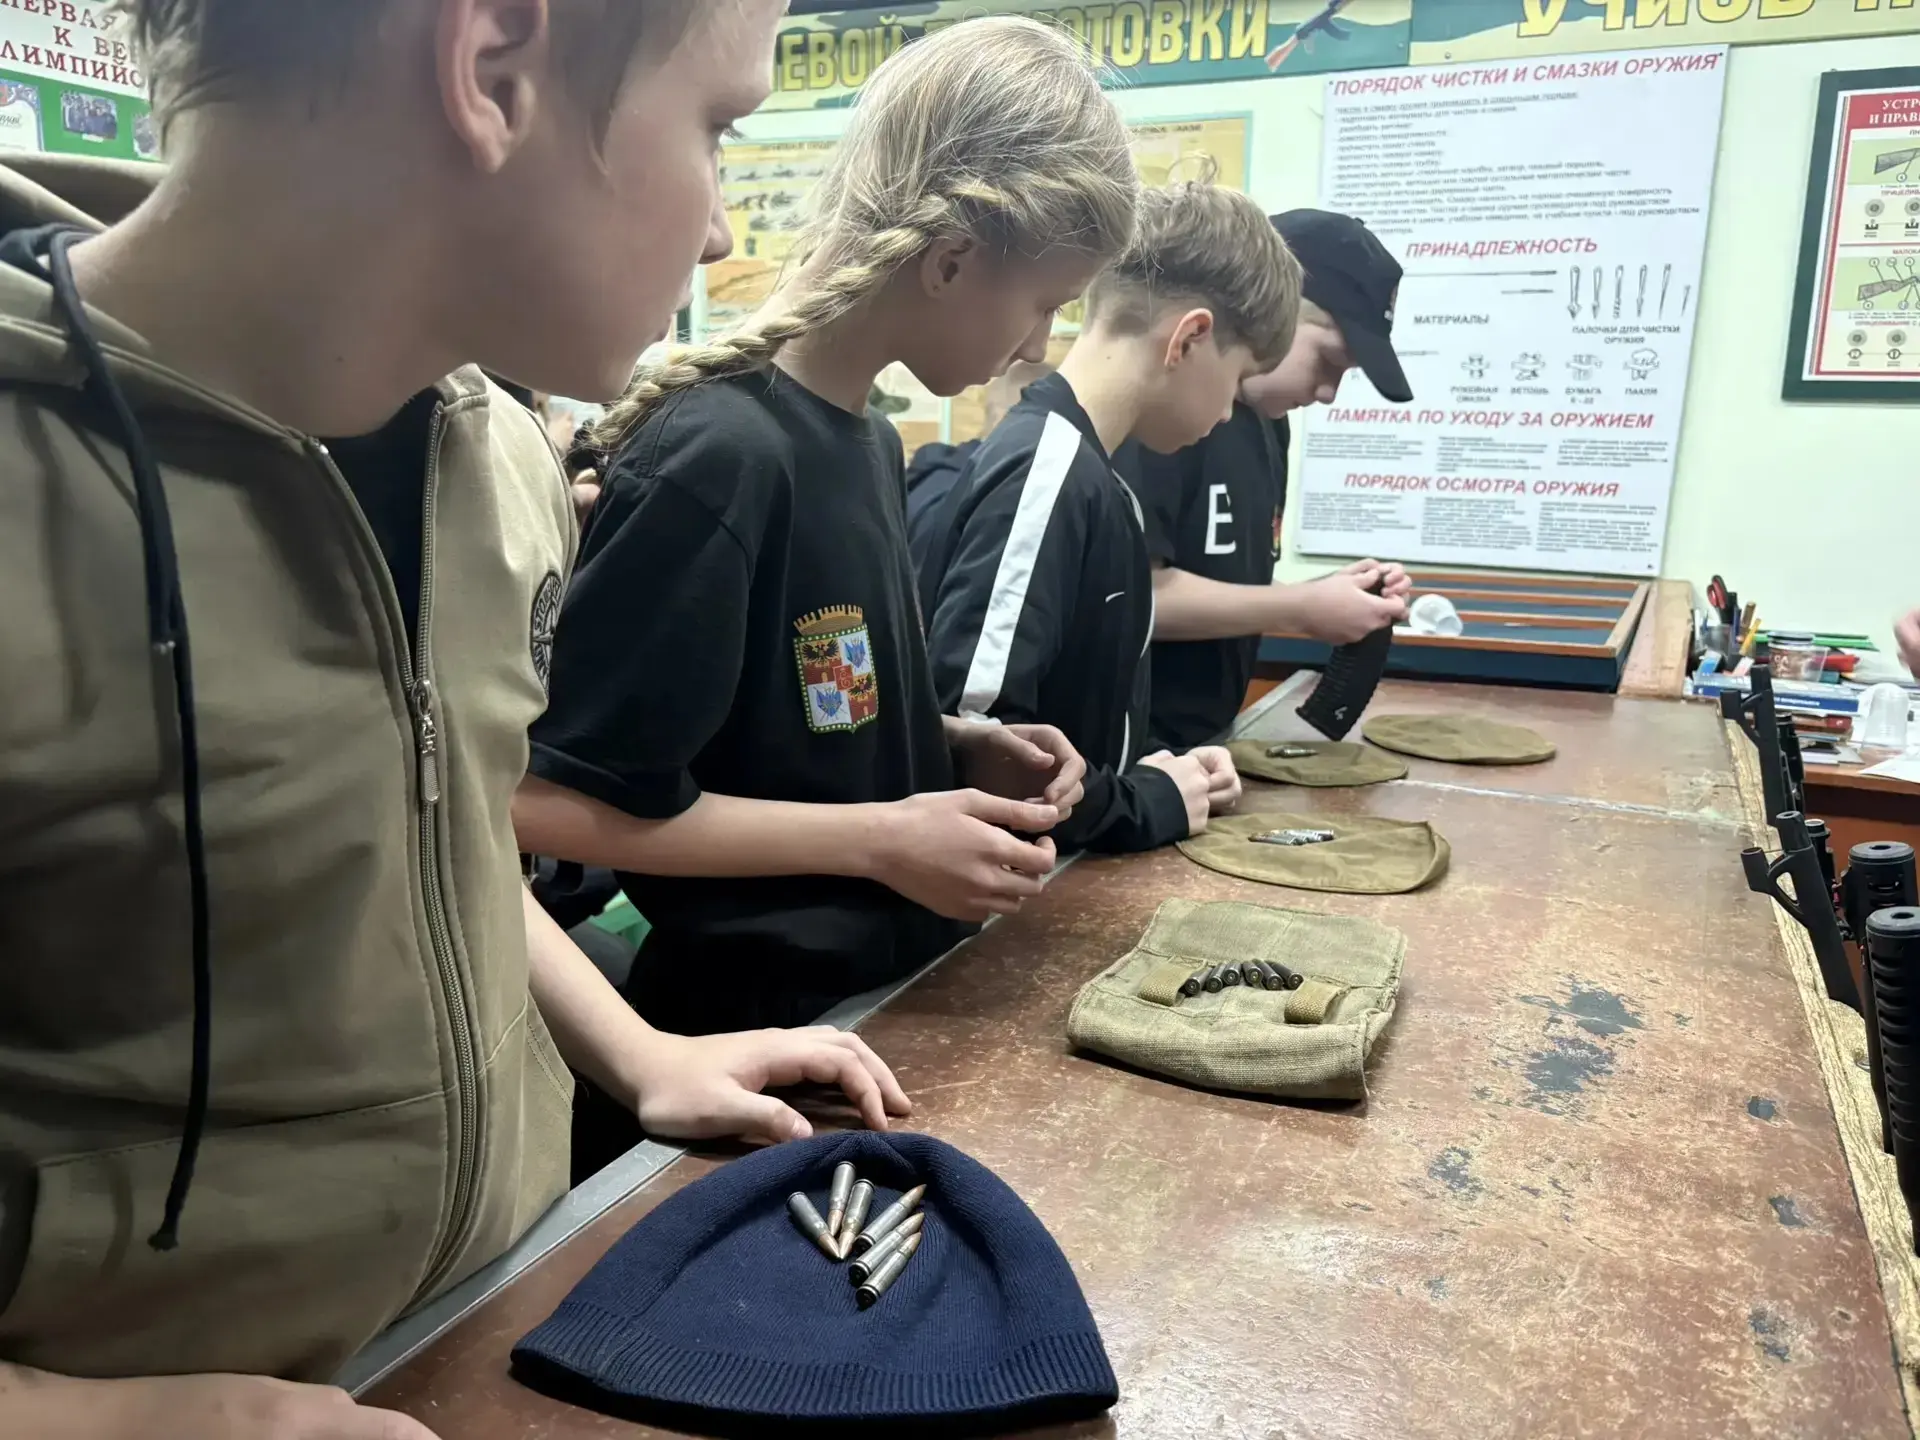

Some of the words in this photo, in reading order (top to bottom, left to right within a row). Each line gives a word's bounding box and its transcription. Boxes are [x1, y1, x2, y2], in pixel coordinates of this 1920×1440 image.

[53, 25, 73, 48] К
[774, 13, 903, 92] ЕВОЙ
[1334, 76, 1424, 96] ПОРЯДОК
[1432, 68, 1507, 88] ЧИСТКИ
[1514, 67, 1527, 82] И
[1533, 61, 1617, 80] СМАЗКИ
[1625, 53, 1718, 75] ОРУЖИЯ
[1882, 99, 1920, 110] УСТР
[1869, 114, 1880, 124] И
[1883, 112, 1920, 123] ПРАВ
[1406, 237, 1597, 258] ПРИНАДЛЕЖНОСТЬ
[1414, 314, 1490, 325] МАТЕРИАЛЫ
[1572, 326, 1617, 334] ПАЛОЧКИ
[1641, 325, 1681, 333] ЧИСТКИ
[1327, 408, 1412, 424] ПАМЯТКА
[1417, 409, 1444, 425] ПО
[1449, 410, 1515, 428] УХОДУ
[1518, 412, 1544, 427] ЗА
[1550, 412, 1654, 429] ОРУЖИЕМ
[1344, 473, 1431, 492] ПОРЯДОК
[1436, 476, 1527, 494] ОСМОТРА
[1532, 480, 1620, 497] ОРУЖИЯ
